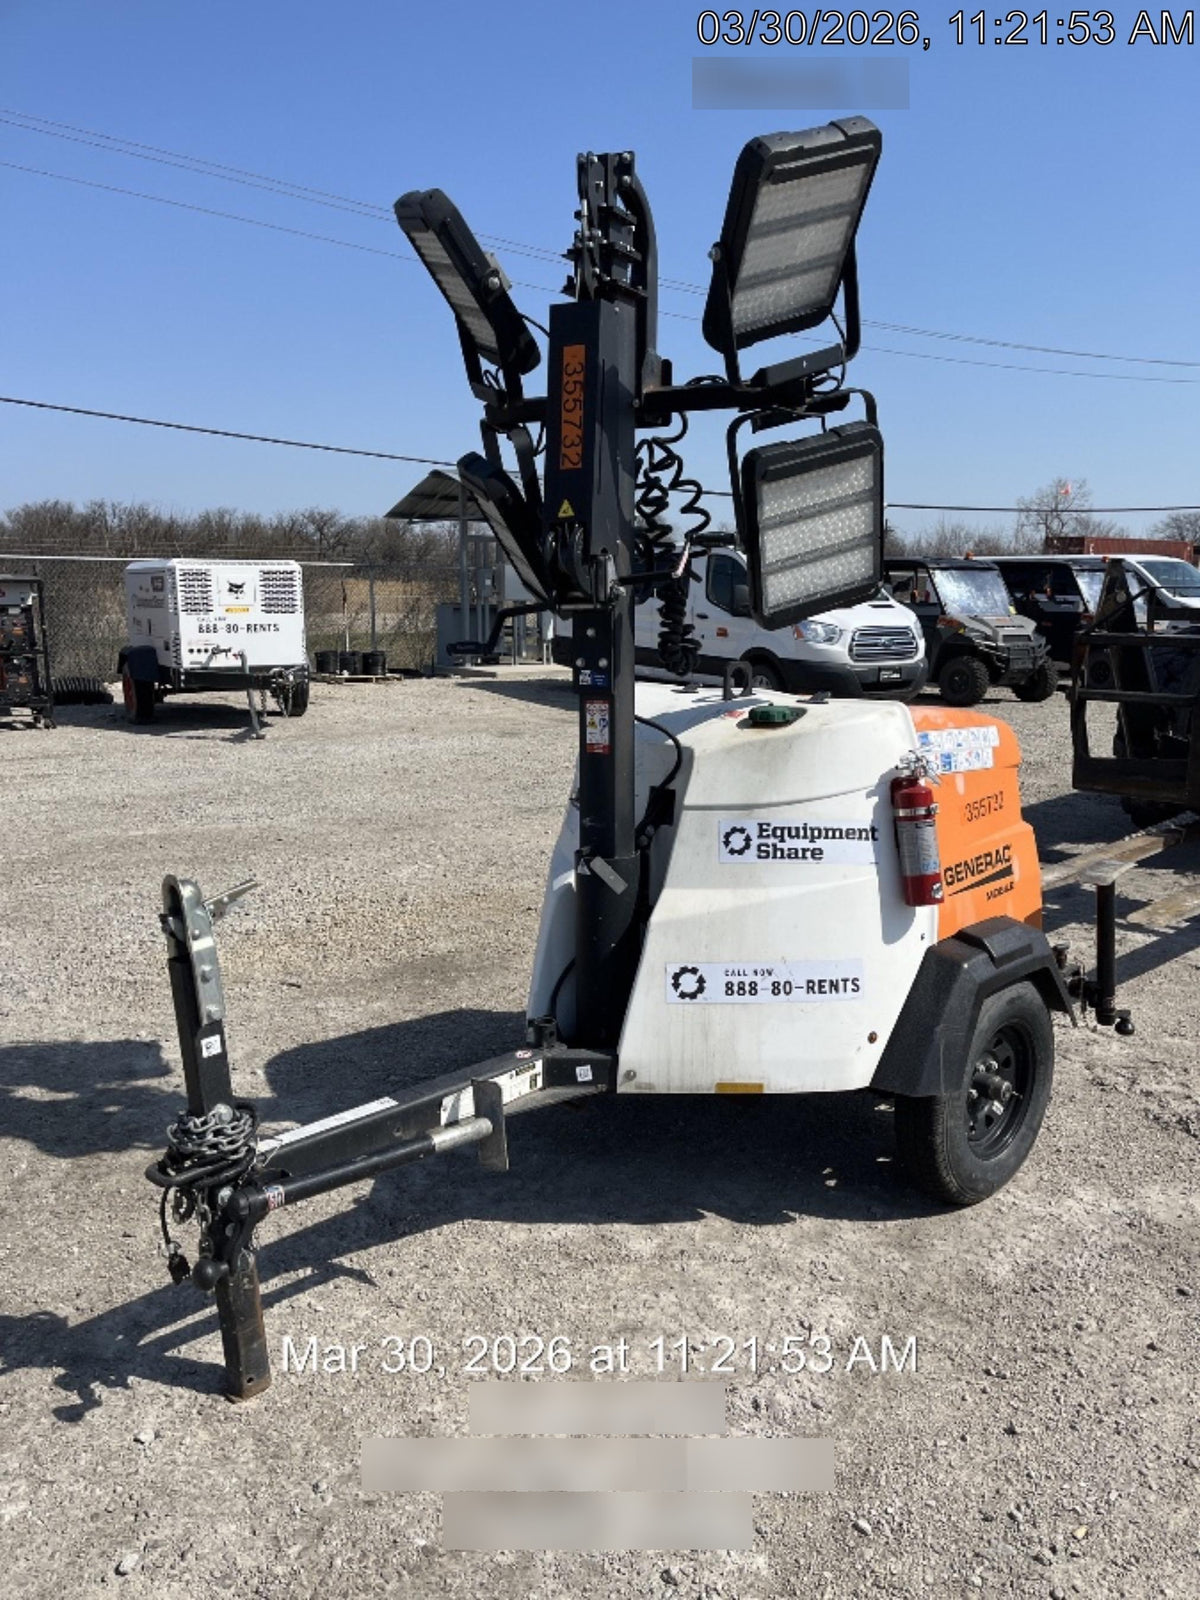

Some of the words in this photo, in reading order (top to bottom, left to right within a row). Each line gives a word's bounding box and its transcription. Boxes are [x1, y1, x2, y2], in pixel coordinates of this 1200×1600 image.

[561, 361, 584, 467] 355732
[756, 822, 879, 842] Equipment
[756, 843, 824, 861] Share
[943, 843, 1013, 887] GENERAC
[724, 968, 748, 978] CALL
[752, 968, 774, 977] NOW
[724, 977, 860, 997] 888-80-RENTS
